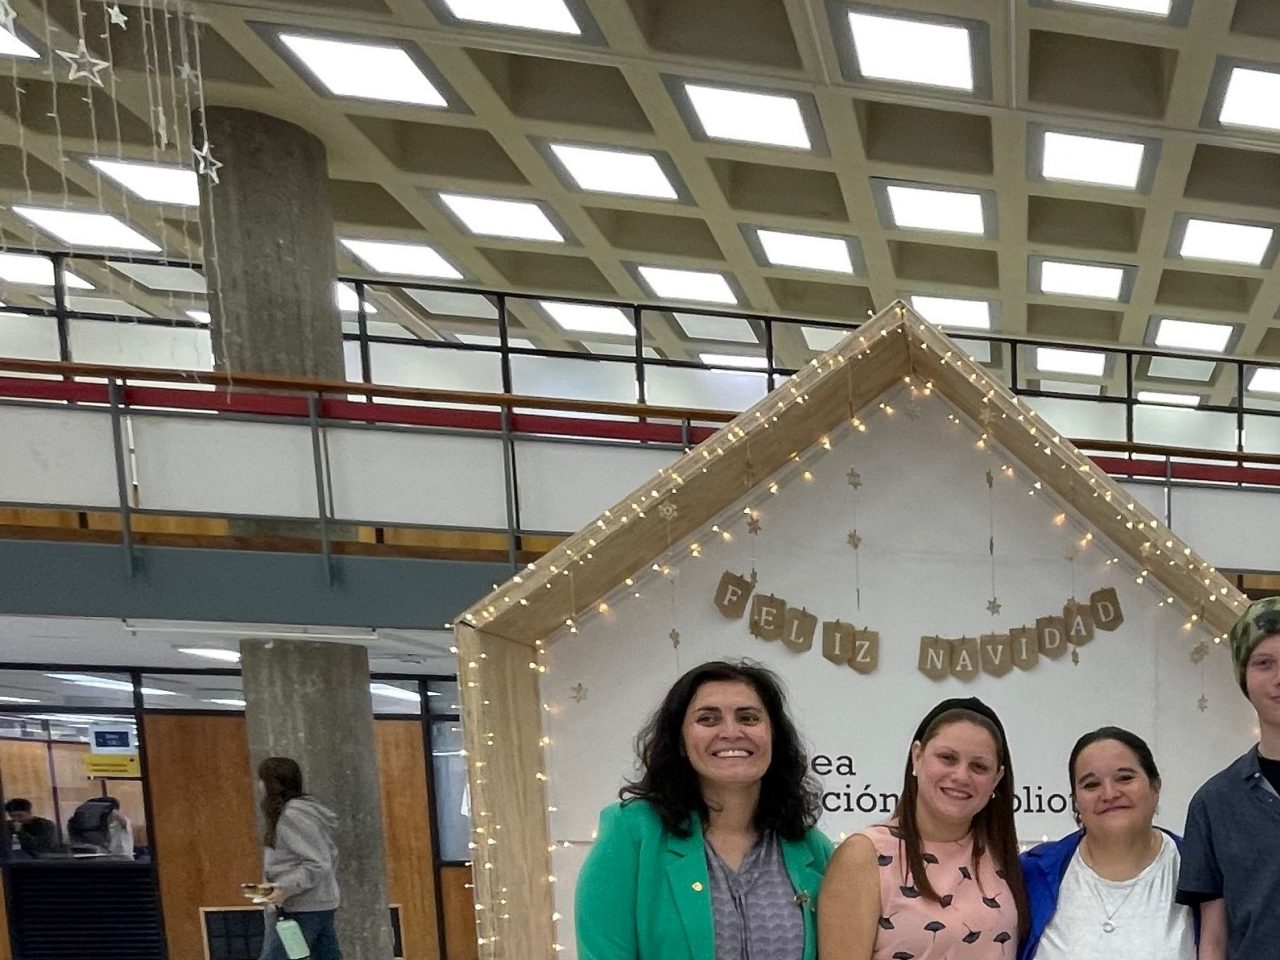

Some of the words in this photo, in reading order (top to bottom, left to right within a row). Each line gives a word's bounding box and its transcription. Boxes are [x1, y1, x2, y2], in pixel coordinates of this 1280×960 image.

[721, 583, 872, 663] FELIZ
[925, 601, 1115, 671] NAVIDAD
[810, 754, 857, 776] ea
[821, 783, 899, 813] ción
